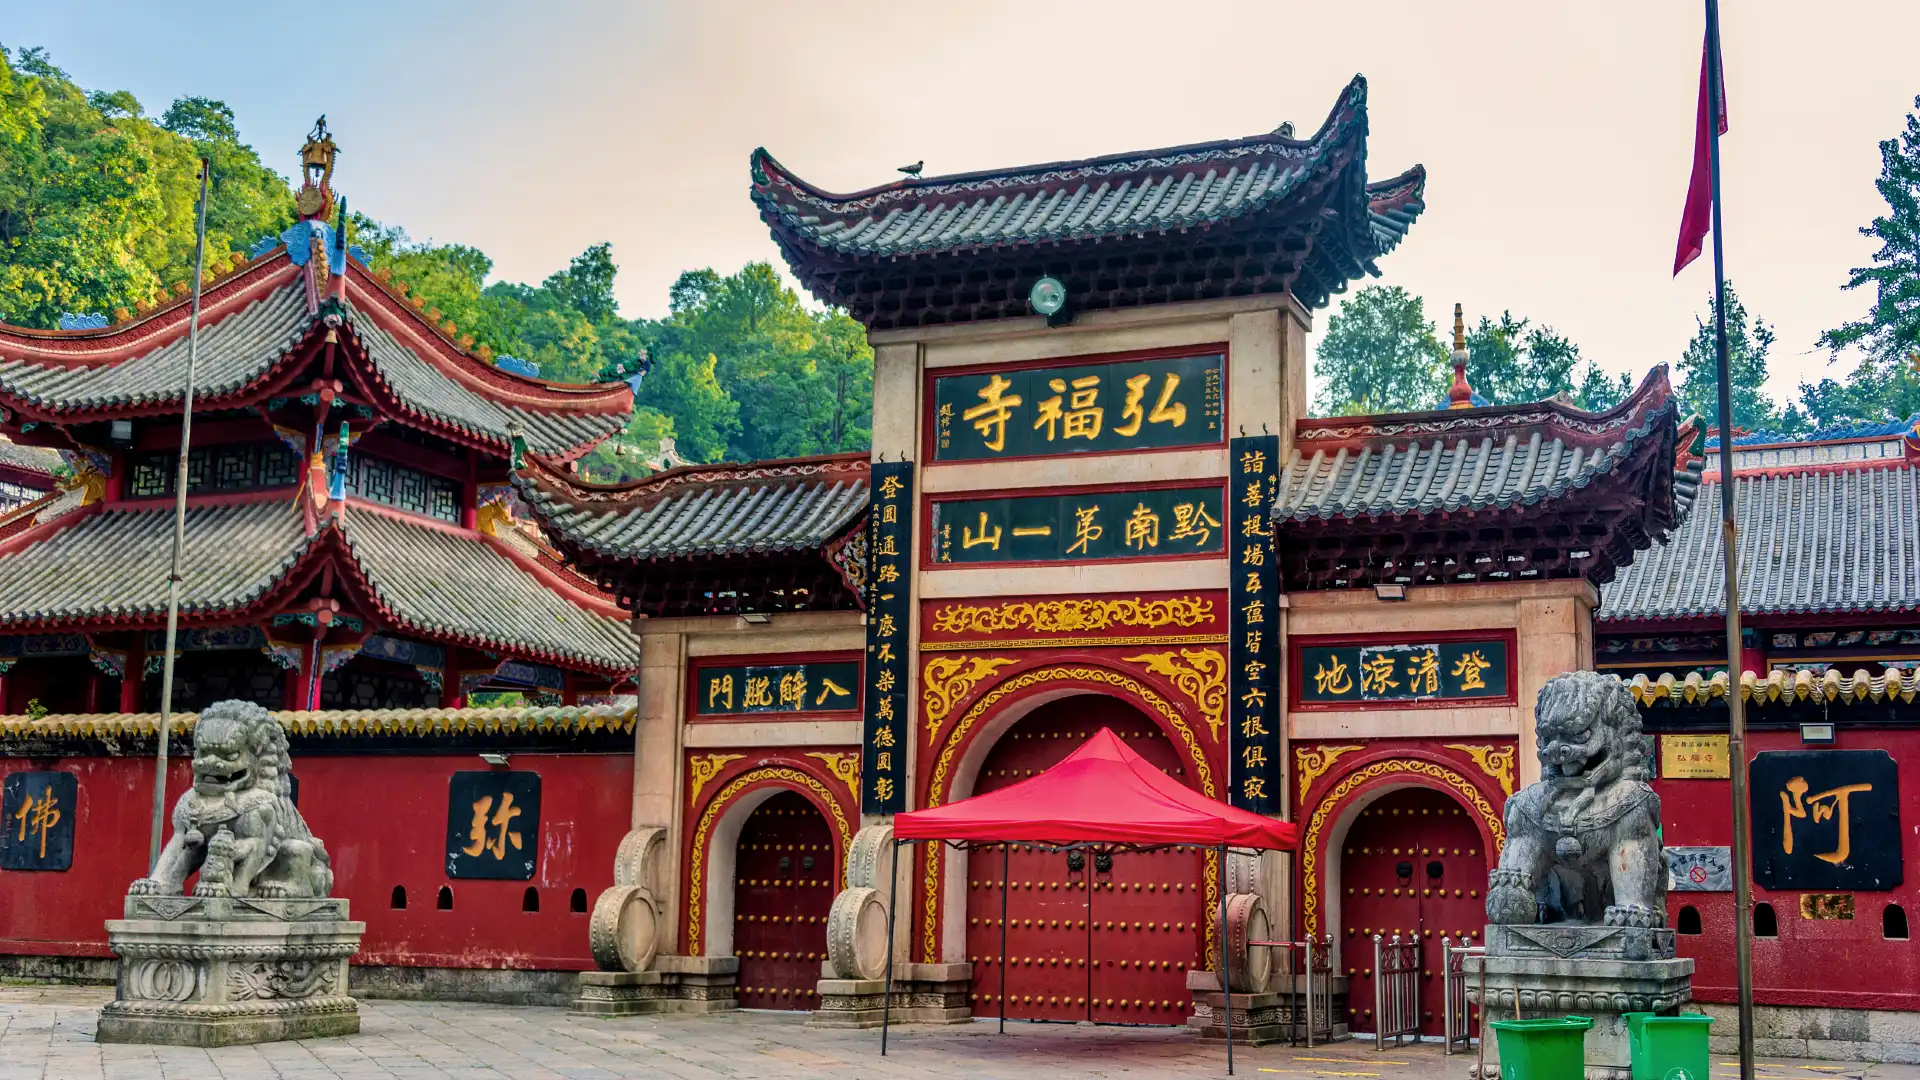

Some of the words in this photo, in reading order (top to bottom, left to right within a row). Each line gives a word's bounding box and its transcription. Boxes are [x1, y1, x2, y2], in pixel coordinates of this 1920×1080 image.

[962, 373, 1187, 452] 弘福寺
[962, 501, 1222, 555] 黔南第一山
[15, 785, 61, 859] 佛
[1780, 776, 1873, 864] 阿
